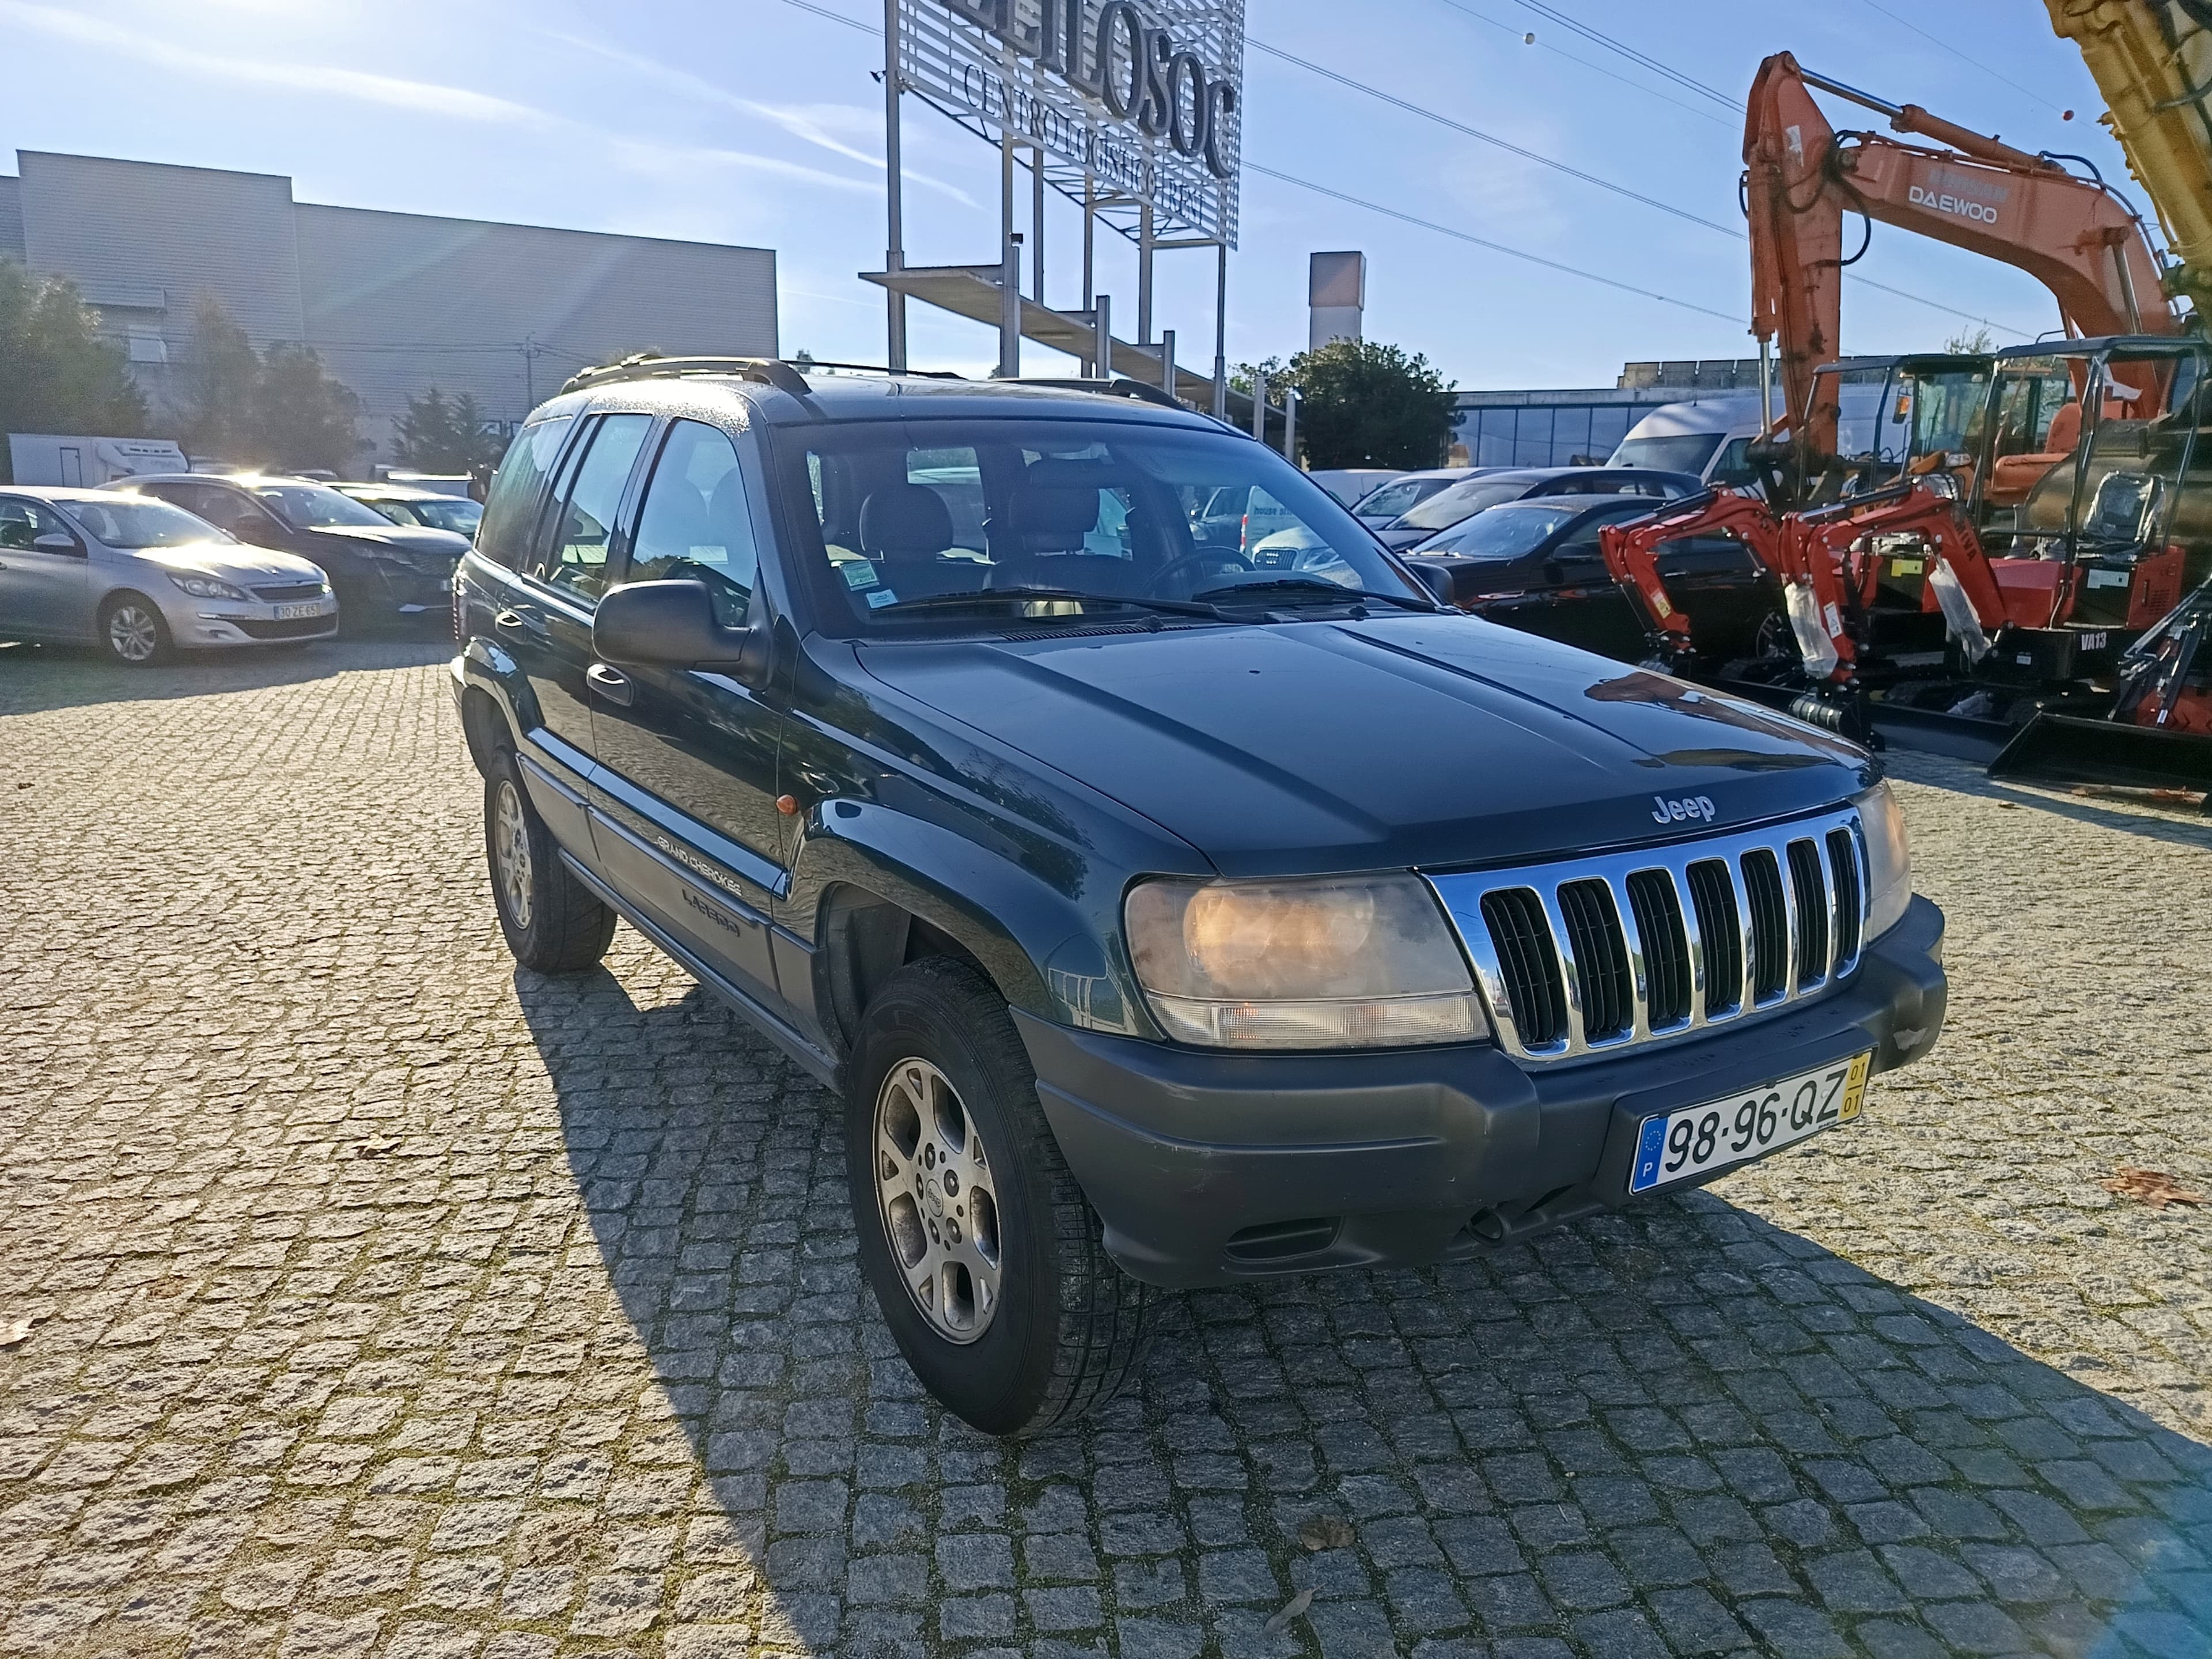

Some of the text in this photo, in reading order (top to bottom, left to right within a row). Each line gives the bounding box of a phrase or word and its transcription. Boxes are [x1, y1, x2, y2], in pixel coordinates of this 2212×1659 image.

[939, 0, 1236, 179] ILOSOC
[965, 64, 1057, 147] CENTRO
[1908, 185, 1998, 224] DAEWOO
[2081, 632, 2107, 650] VA13
[1651, 796, 1715, 824] Jeep
[656, 836, 743, 896] GRAND CHEROKEE
[1850, 1062, 1865, 1081] 01
[1844, 1094, 1860, 1112] 01
[1642, 1161, 1653, 1177] P
[928, 1188, 941, 1207] Jeep
